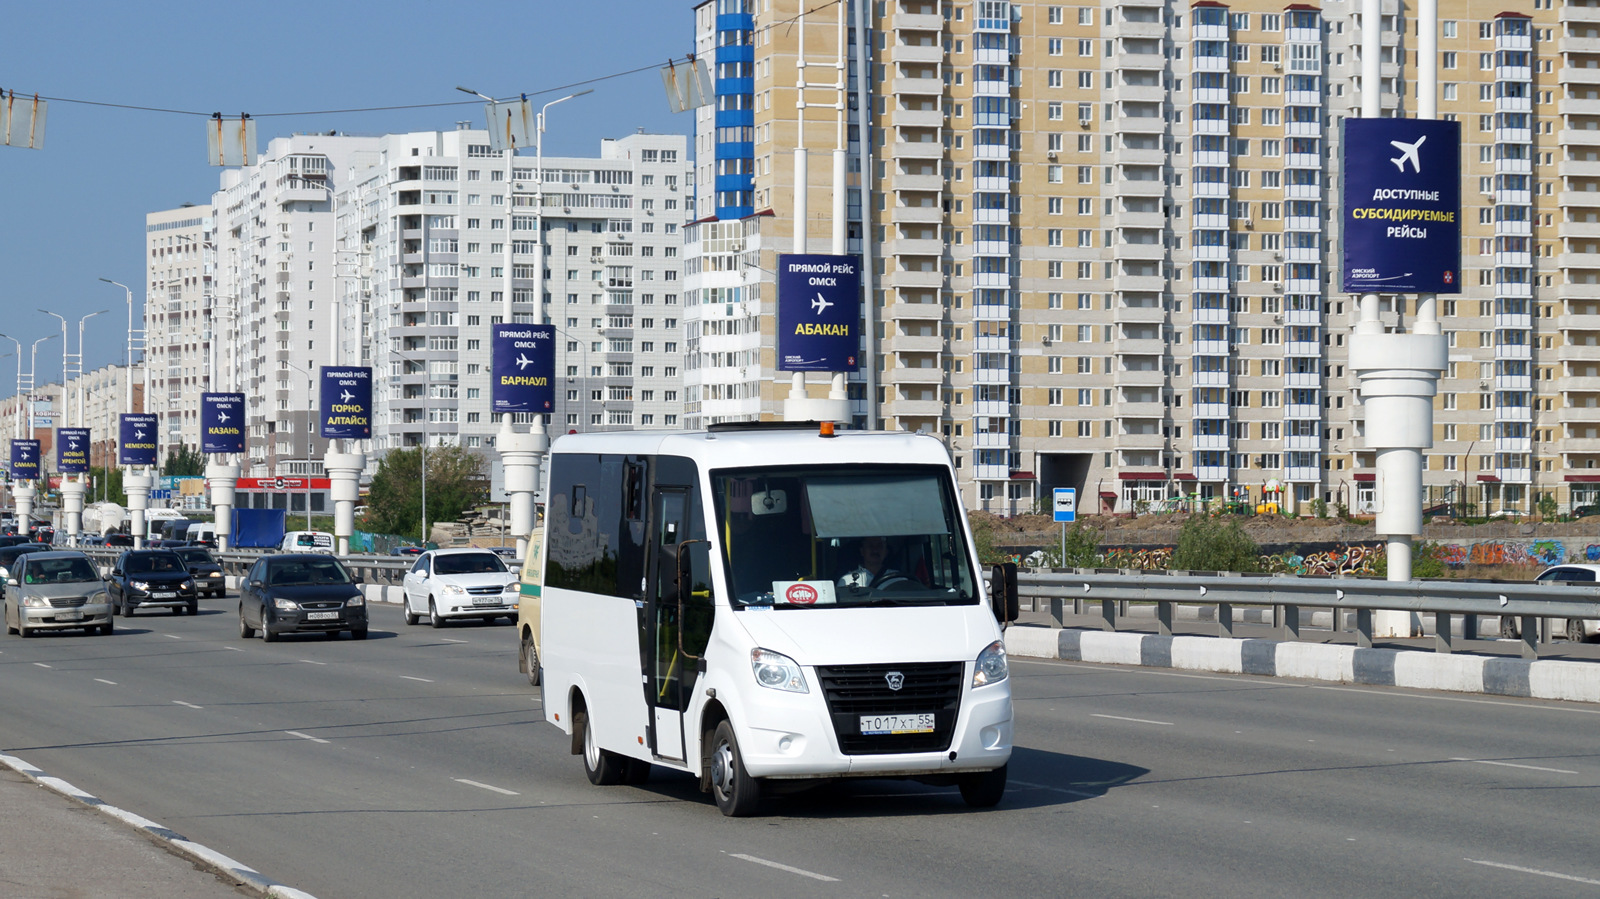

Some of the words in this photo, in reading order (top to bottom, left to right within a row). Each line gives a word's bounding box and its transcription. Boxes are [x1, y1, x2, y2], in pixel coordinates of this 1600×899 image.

[1372, 188, 1440, 201] ДОСТУПНЫЕ
[1352, 208, 1455, 222] СУБСИДИРУЕМЫЕ
[1386, 224, 1427, 238] РЕЙСЫ
[788, 262, 831, 272] ПРЯМОЙ
[832, 264, 854, 274] РЕЙС
[808, 277, 836, 286] ОМСК
[500, 330, 532, 339] ПРЯМОЙ
[533, 331, 550, 339] РЕЙС
[794, 323, 848, 336] АБАКАН
[501, 376, 547, 386] БАРНАУЛ
[332, 404, 364, 412] ГОРНО-
[327, 415, 367, 425] АЛТАЙСК
[208, 427, 239, 435] КАЗАНЬ
